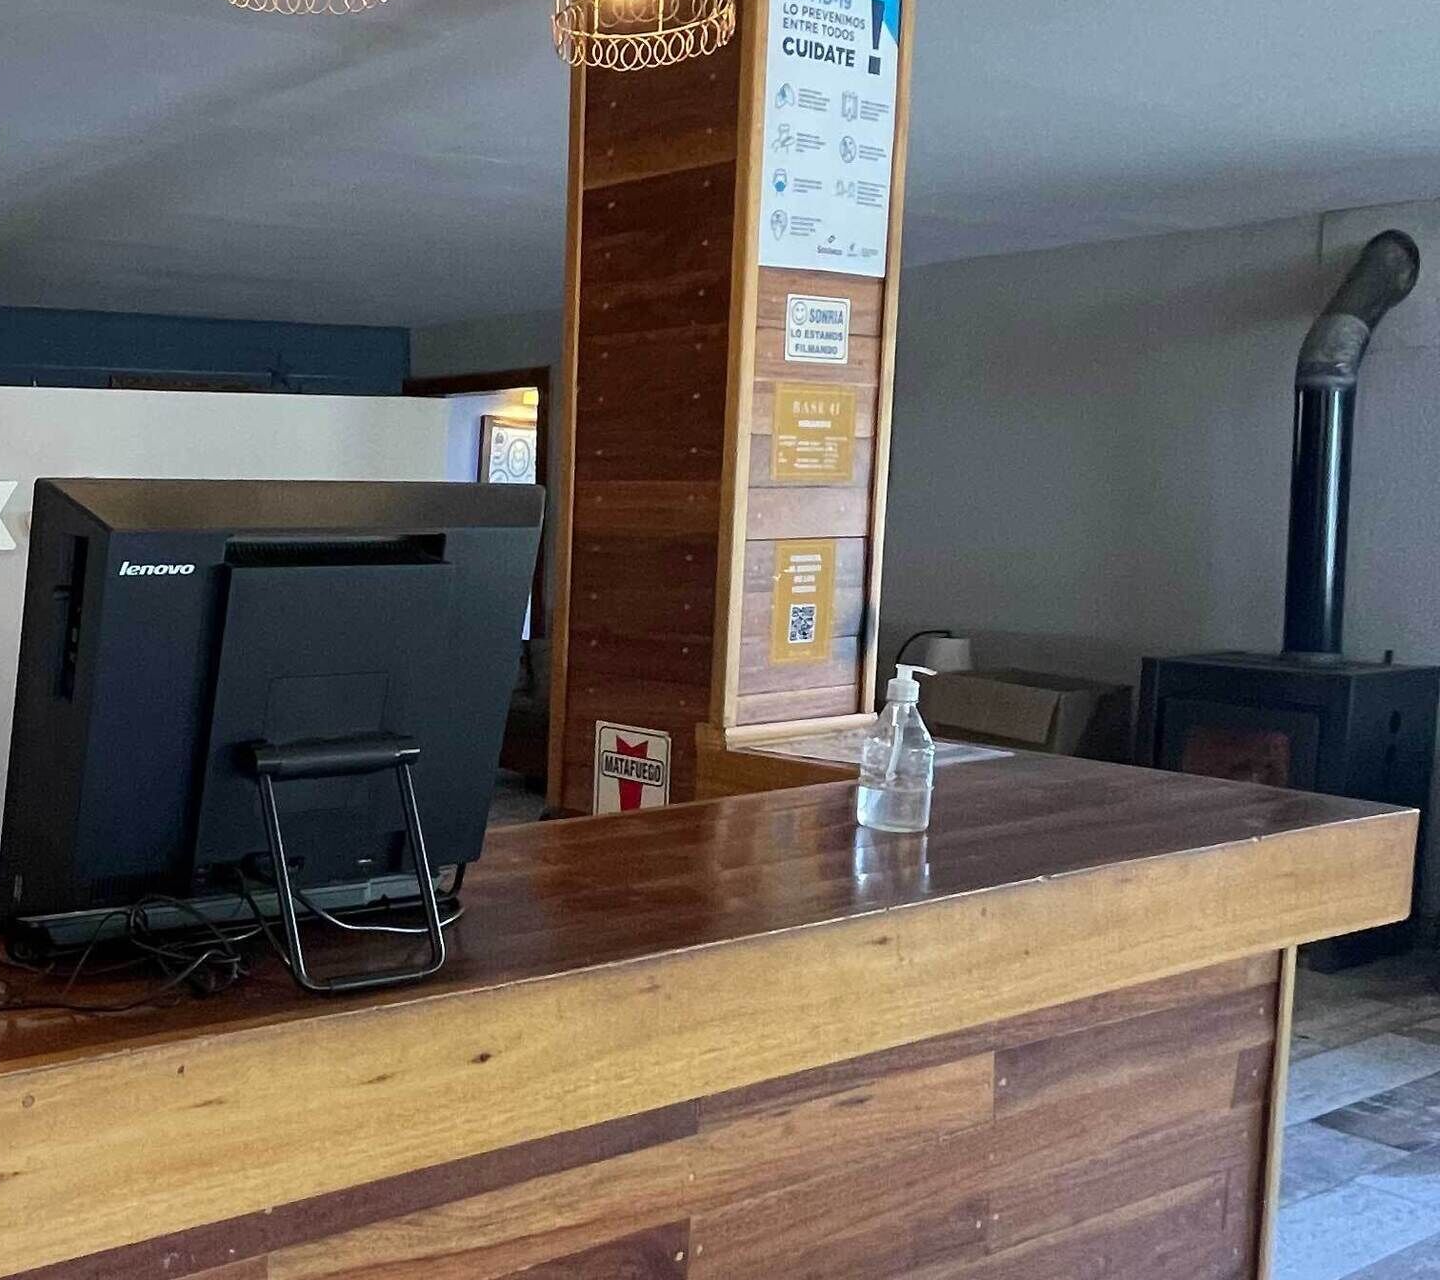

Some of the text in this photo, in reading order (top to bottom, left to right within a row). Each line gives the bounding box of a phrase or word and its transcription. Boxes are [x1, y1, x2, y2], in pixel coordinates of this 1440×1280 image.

[783, 3, 866, 31] LO PREVENIMOS
[783, 17, 856, 42] ENTRE TODOS
[782, 36, 856, 68] CUIDATE
[791, 328, 844, 342] LO ESTAMOS
[794, 343, 839, 356] FILMANDO
[119, 561, 196, 576] lenovo
[605, 755, 661, 783] MATAFUEGO
